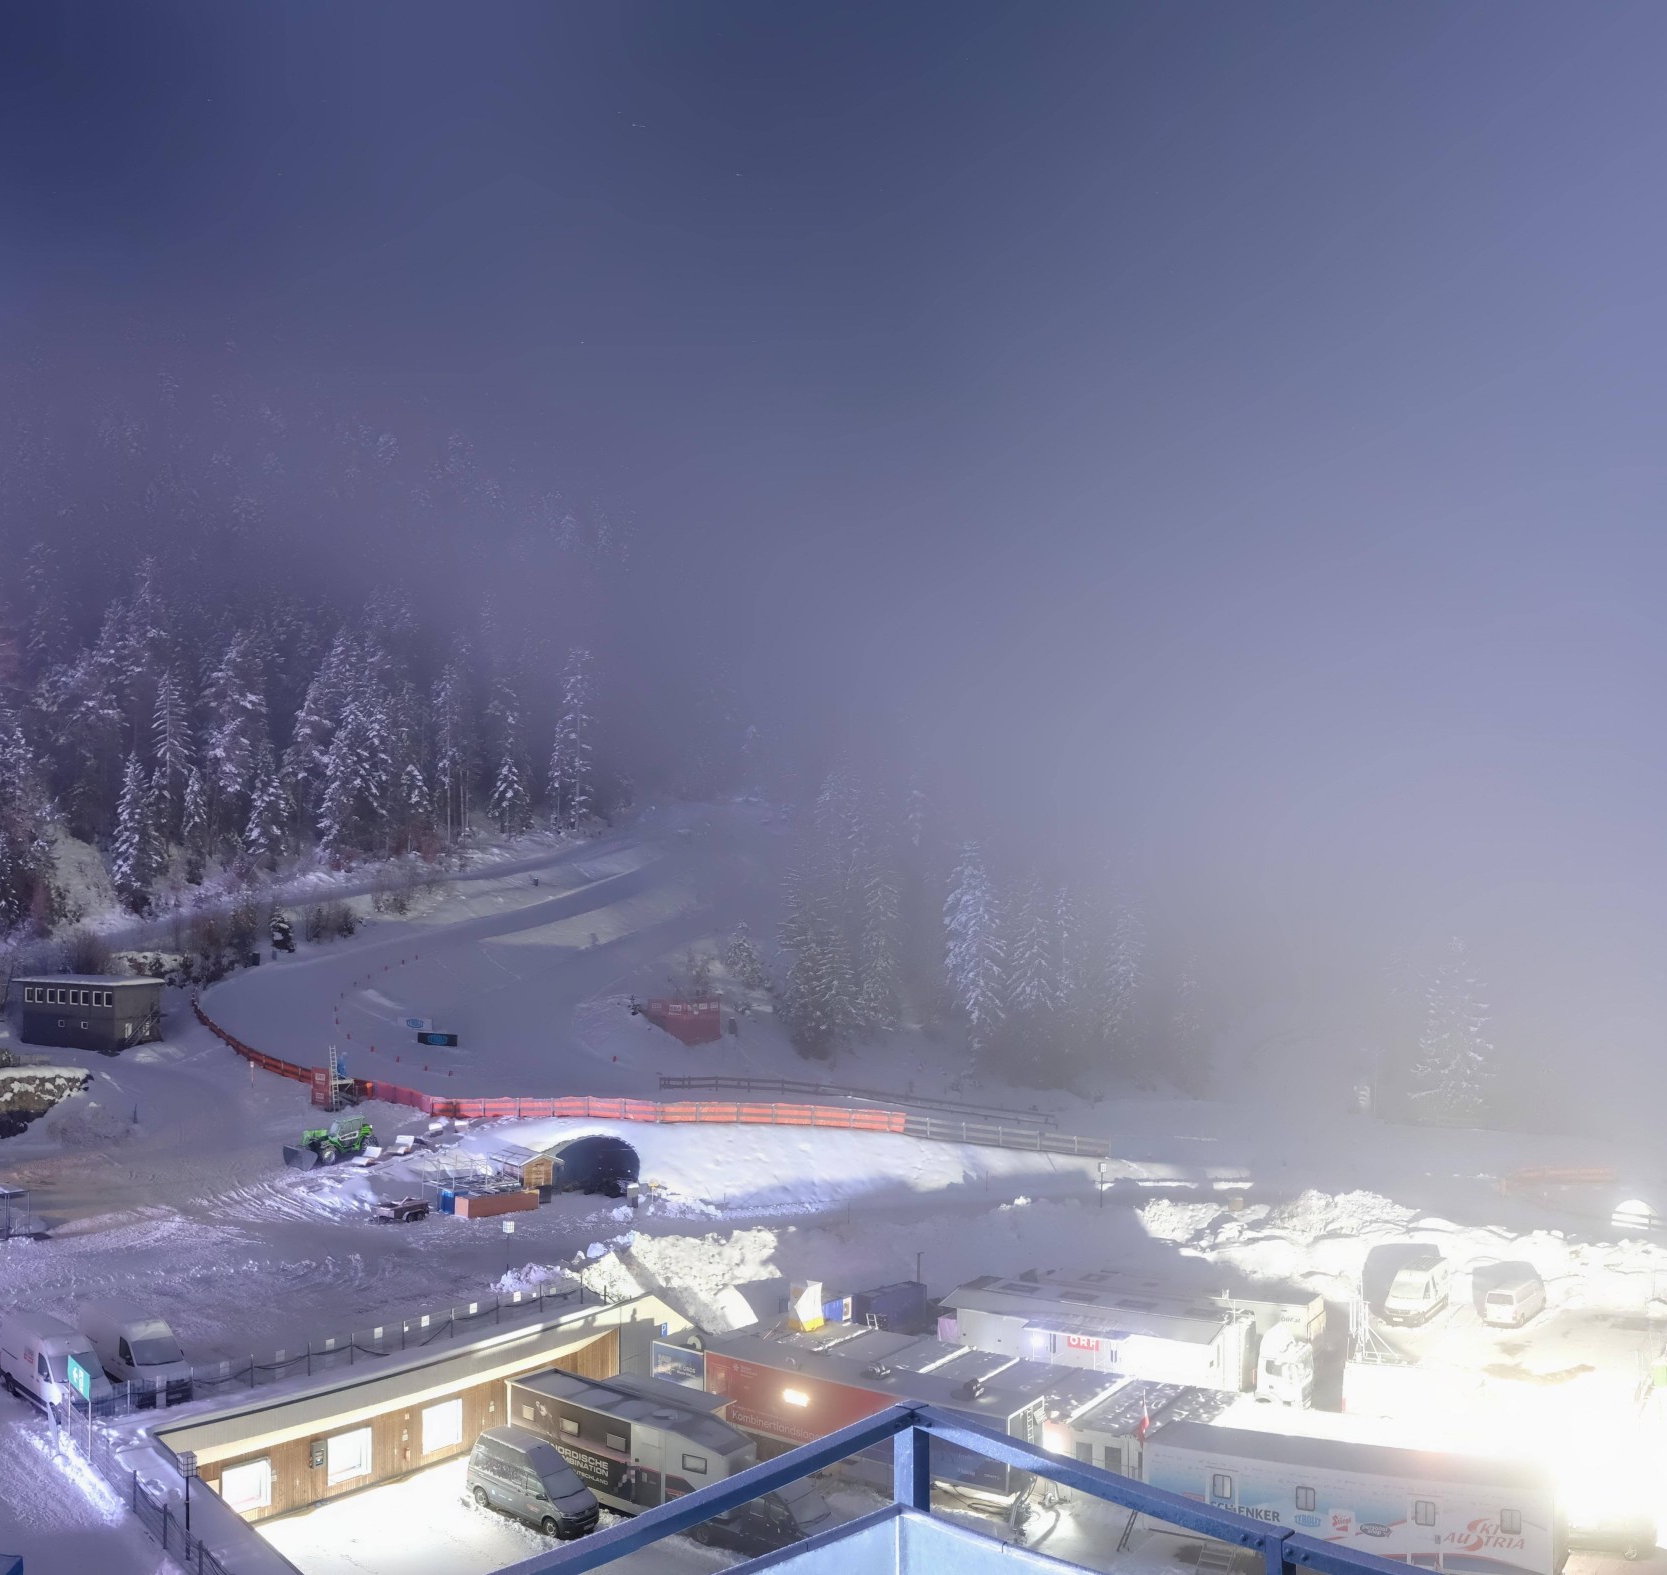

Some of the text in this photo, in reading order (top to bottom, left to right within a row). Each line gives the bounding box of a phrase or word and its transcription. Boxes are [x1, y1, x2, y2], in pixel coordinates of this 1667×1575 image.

[661, 1323, 667, 1336] P
[1069, 1335, 1095, 1348] ORF
[562, 1454, 609, 1478] MBINATION
[1294, 1514, 1322, 1527] TYROLIT
[1332, 1515, 1352, 1528] Stiegl
[1362, 1524, 1389, 1532] personal
[1444, 1532, 1526, 1552] AUSTRIA
